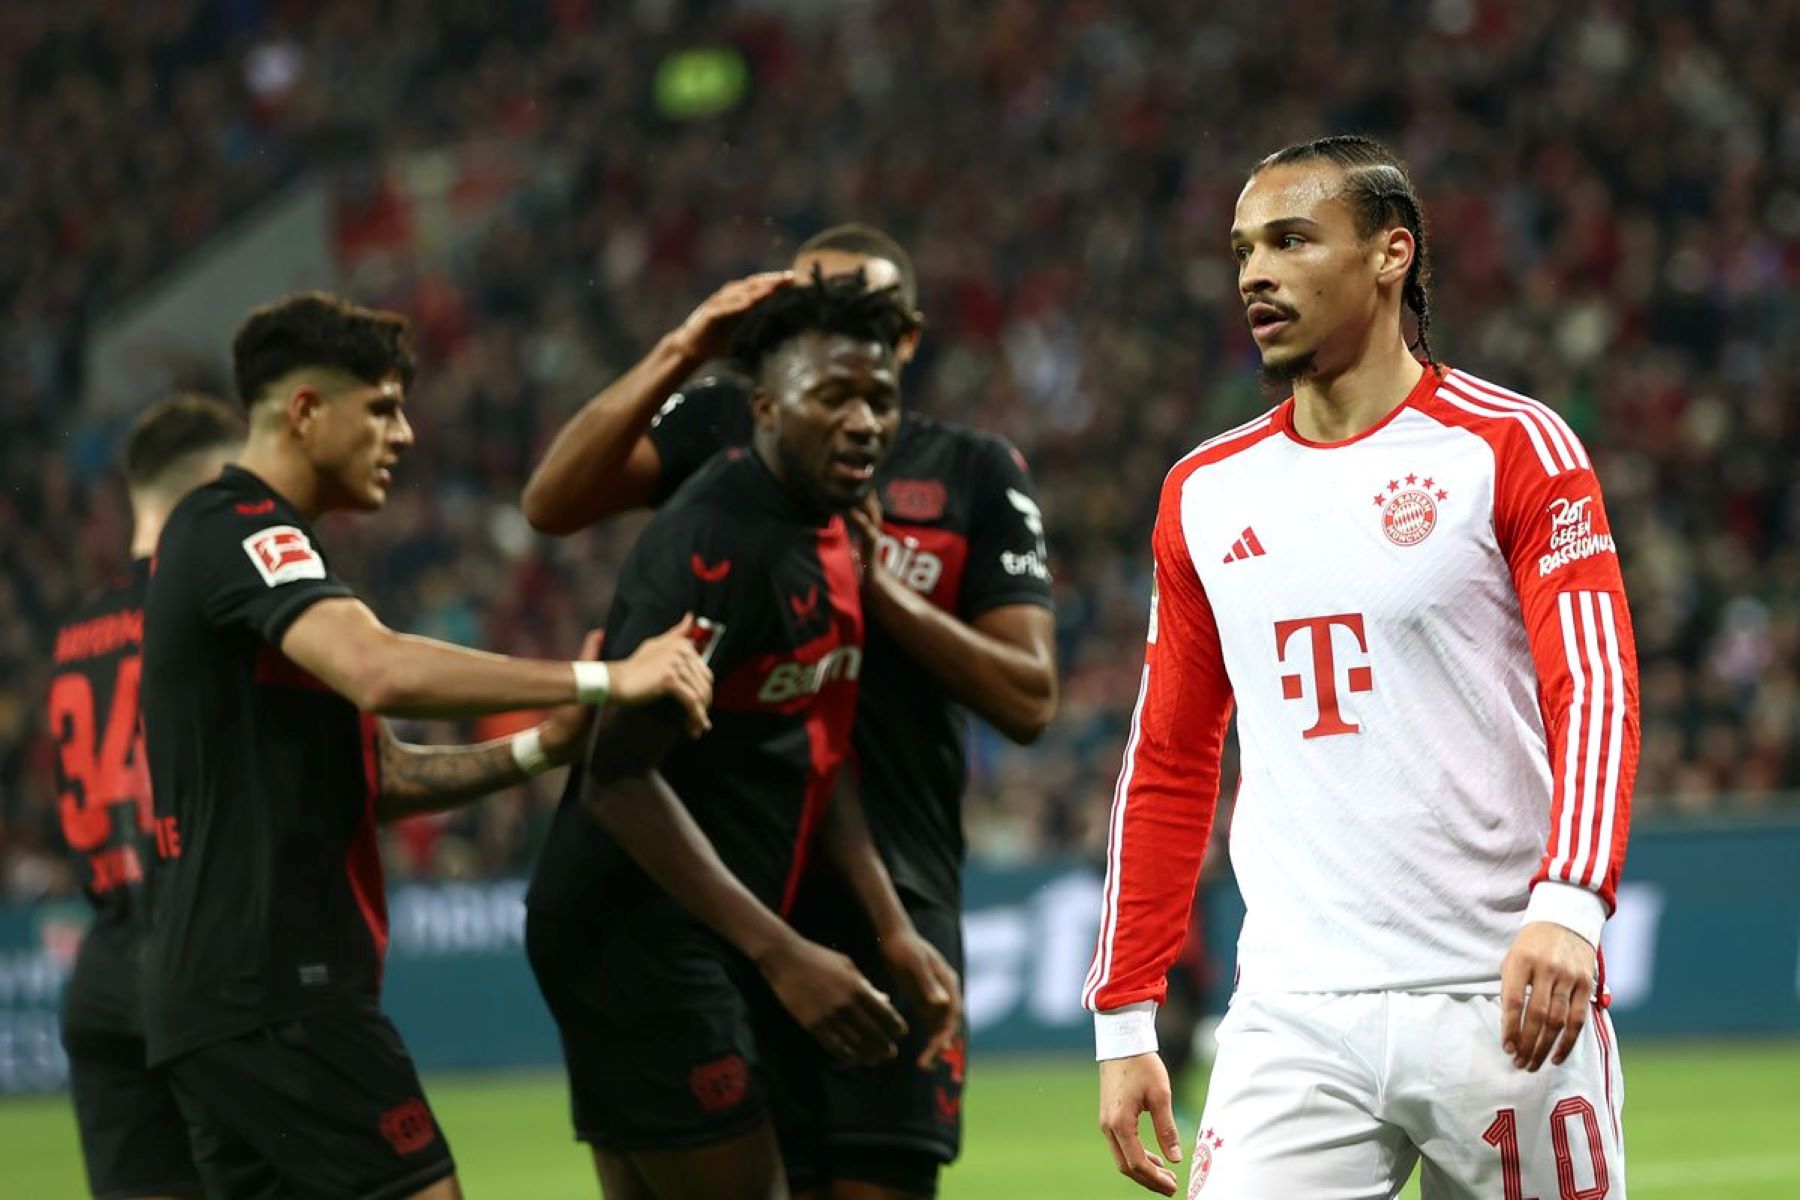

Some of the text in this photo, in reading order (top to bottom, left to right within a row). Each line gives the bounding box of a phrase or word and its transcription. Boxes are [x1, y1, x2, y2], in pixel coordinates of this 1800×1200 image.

[1551, 510, 1591, 550] GEGEN
[1274, 613, 1372, 739] T
[50, 656, 154, 851] 34
[1483, 1096, 1609, 1200] 10
